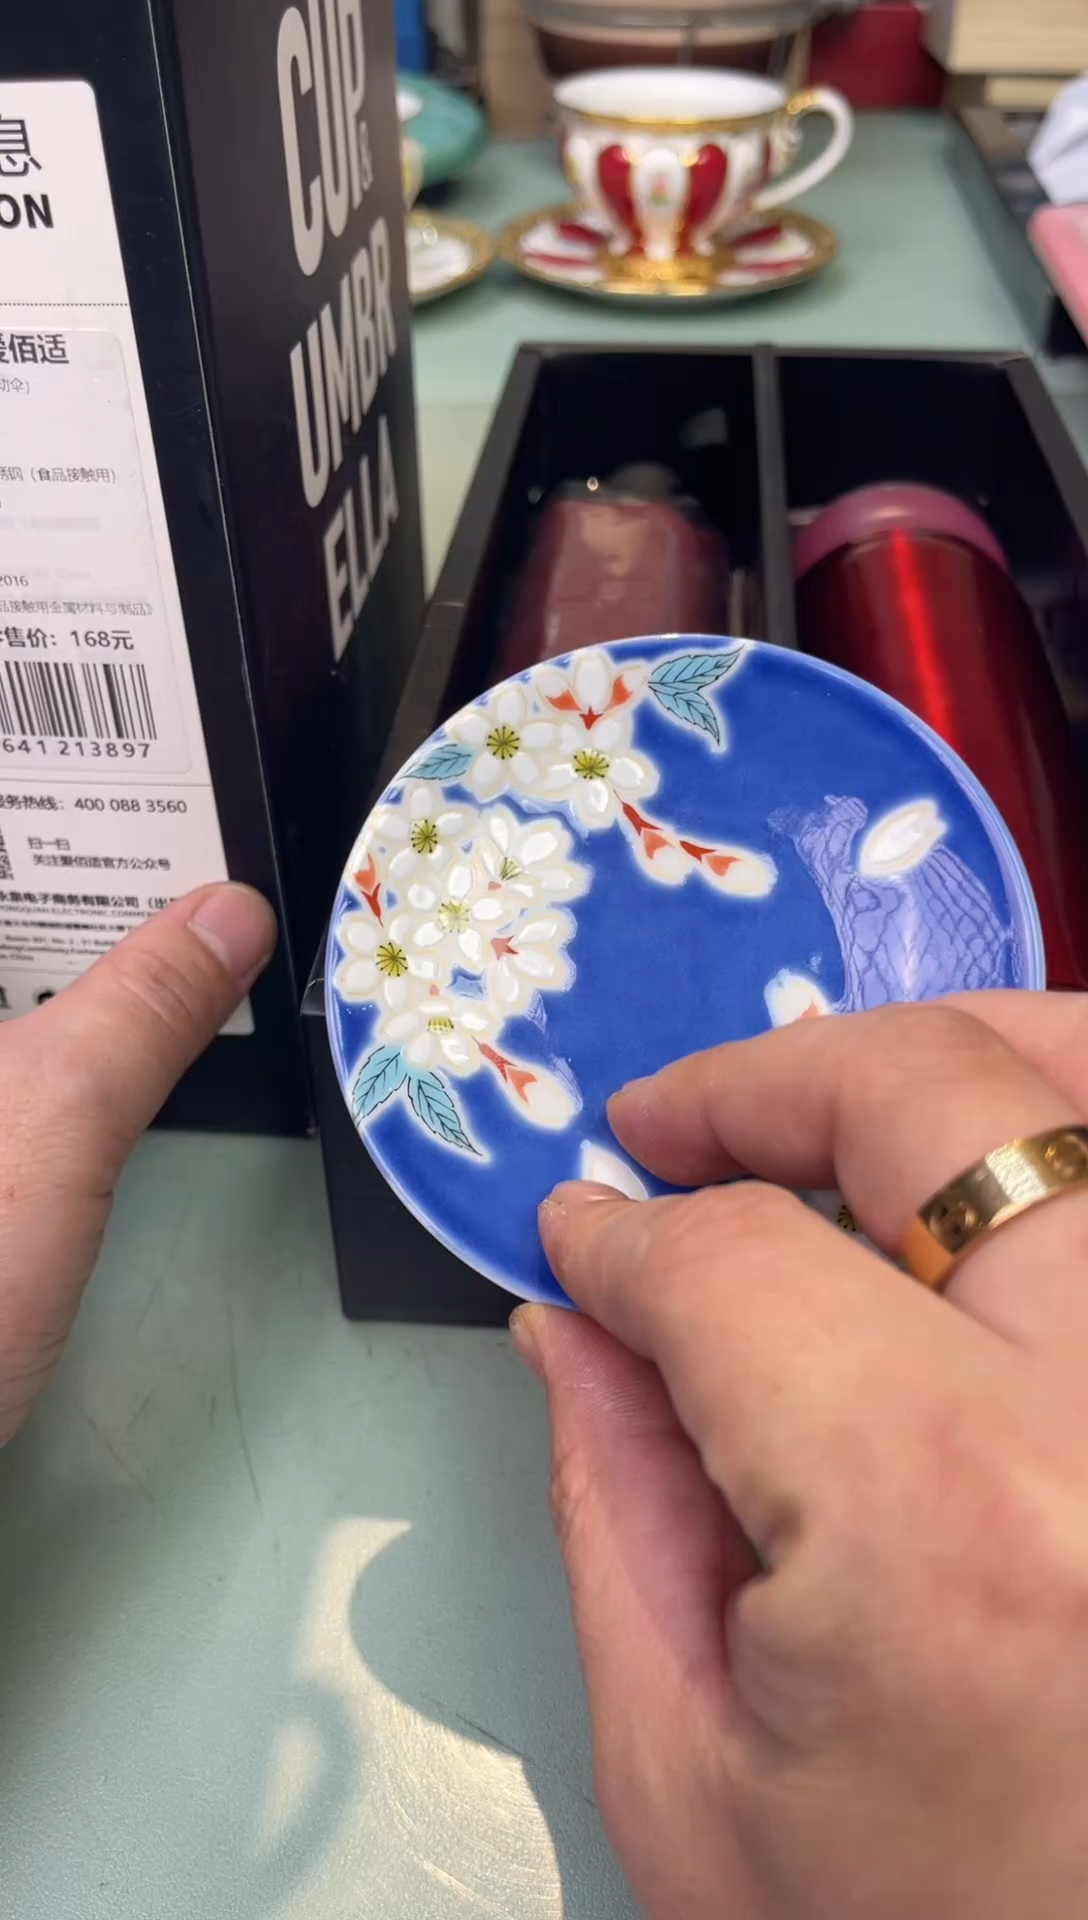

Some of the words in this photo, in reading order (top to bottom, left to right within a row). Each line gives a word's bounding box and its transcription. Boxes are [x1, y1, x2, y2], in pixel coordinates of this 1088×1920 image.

[277, 0, 366, 276] CUP
[290, 216, 398, 508] UMBR
[323, 415, 399, 662] ELLA
[58, 740, 150, 758] 213897
[74, 798, 105, 811] 400
[110, 799, 141, 812] 088
[145, 799, 188, 813] 3560
[27, 836, 71, 851] 扫一扫
